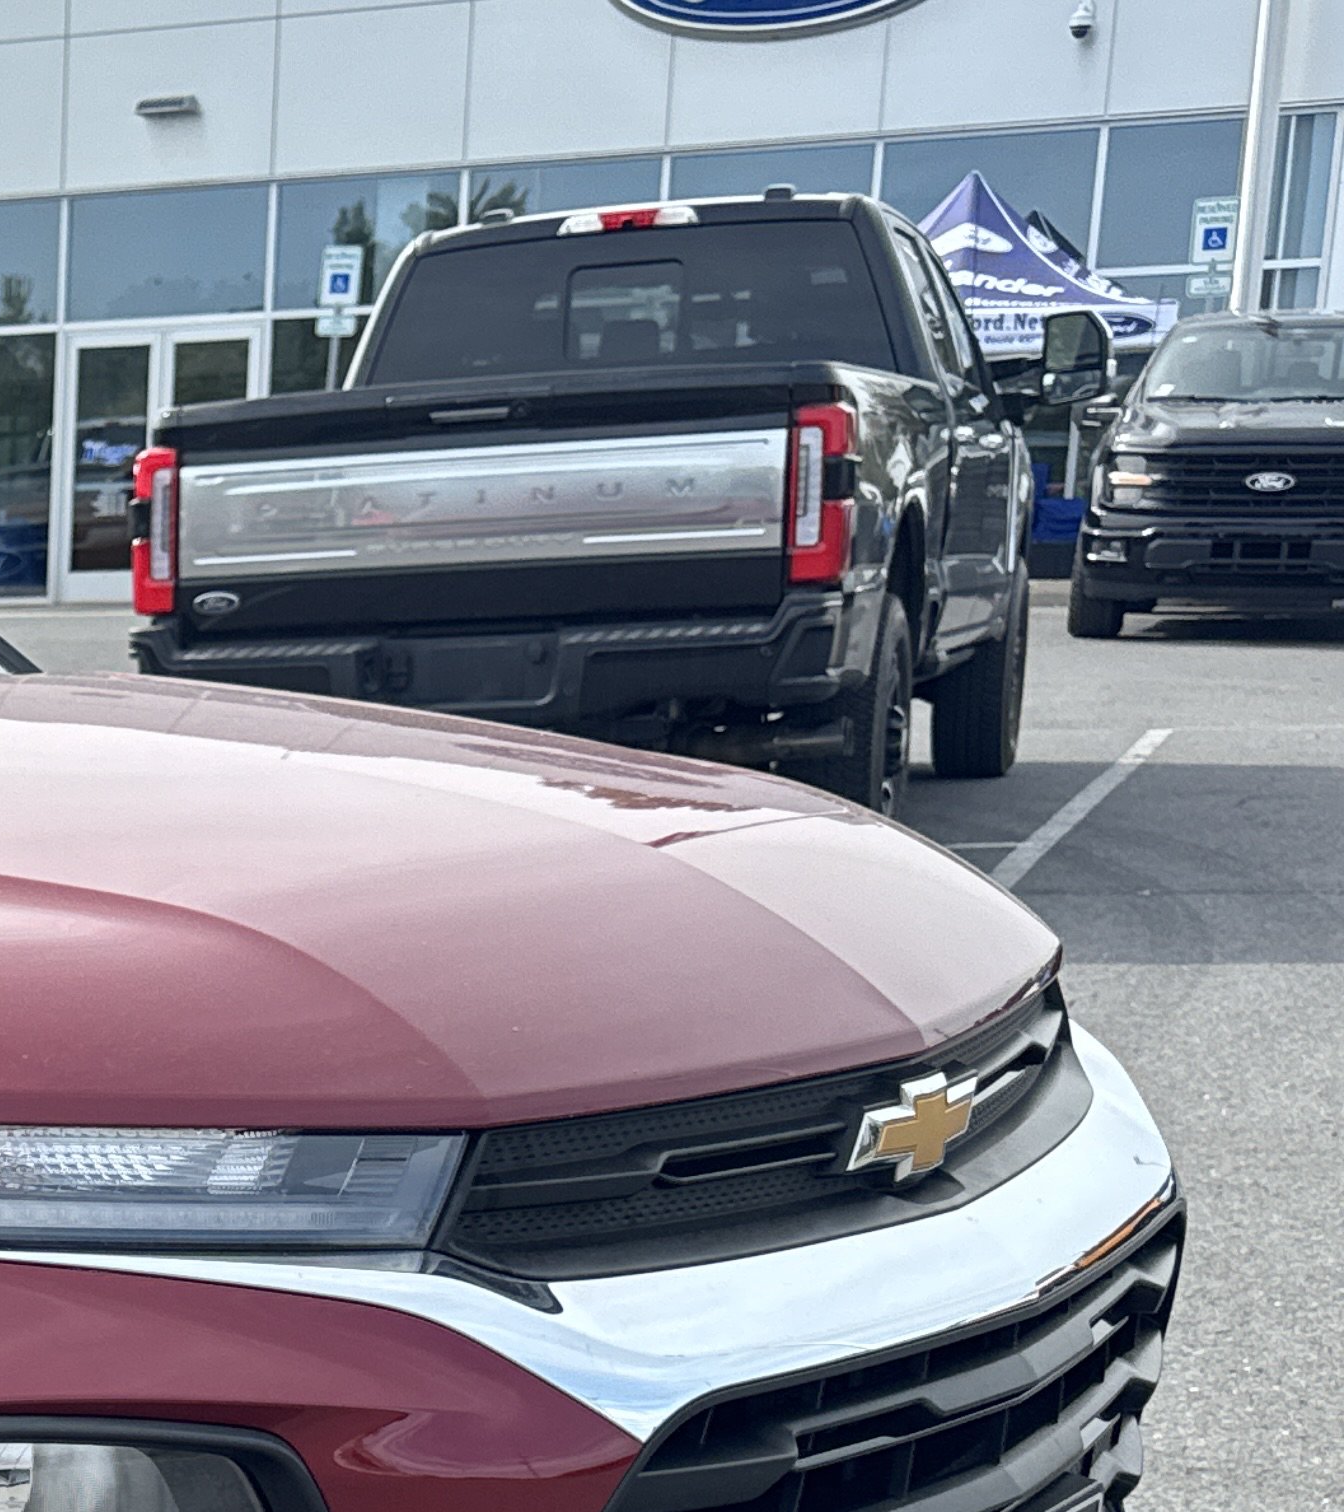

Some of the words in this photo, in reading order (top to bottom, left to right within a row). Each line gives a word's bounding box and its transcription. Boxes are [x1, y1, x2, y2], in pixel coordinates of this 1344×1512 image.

[948, 270, 1064, 298] ander
[966, 313, 1047, 331] ord.Net
[260, 477, 695, 521] PLATINUM
